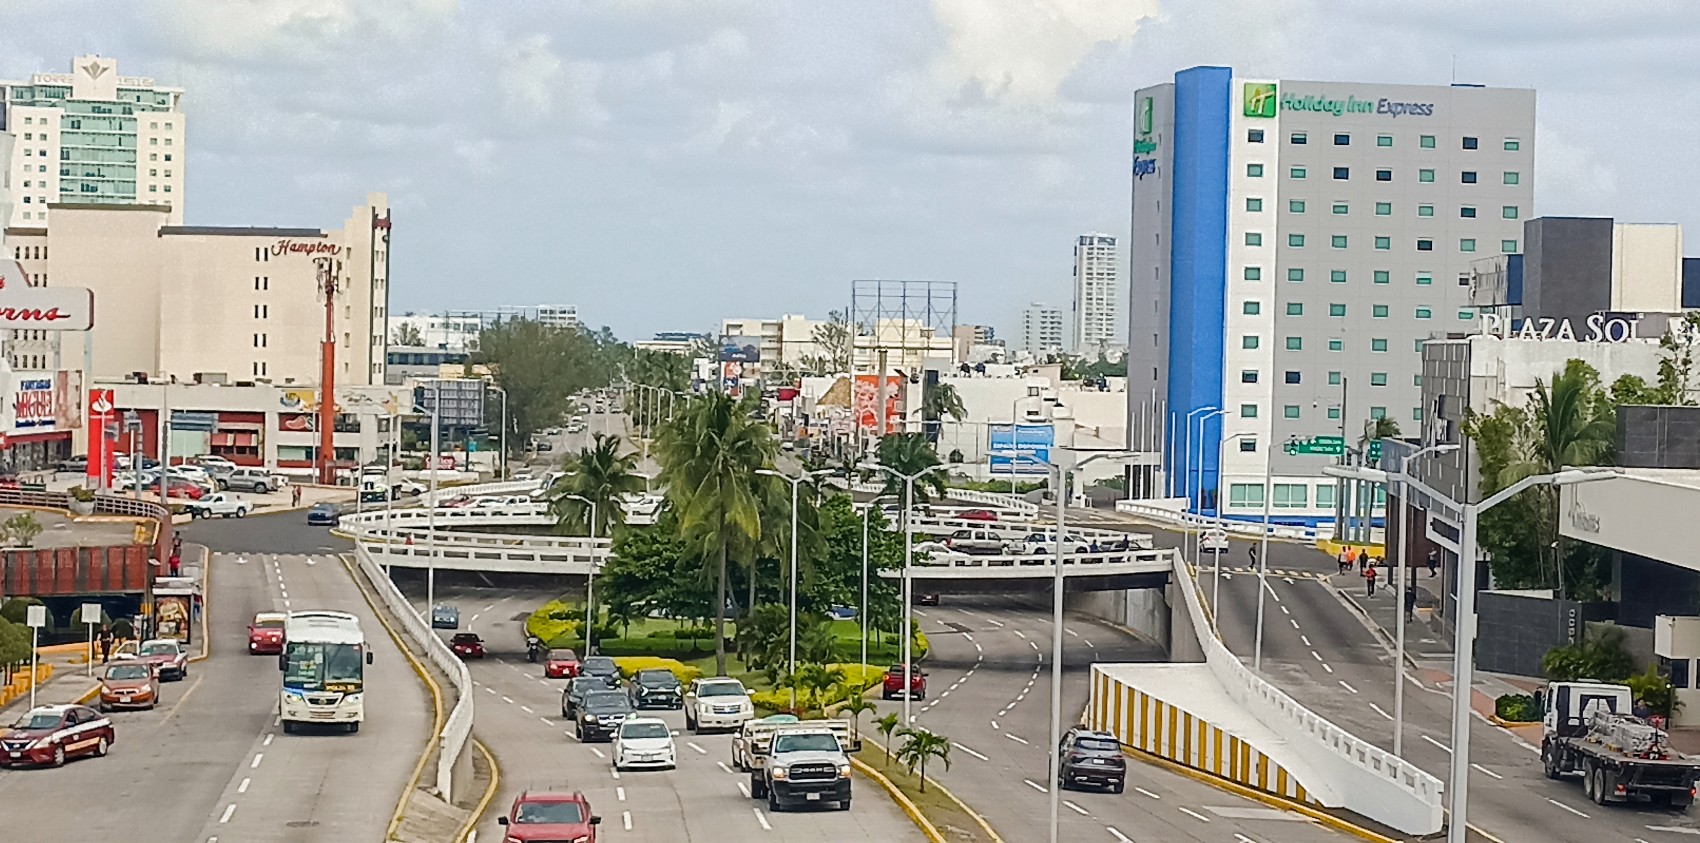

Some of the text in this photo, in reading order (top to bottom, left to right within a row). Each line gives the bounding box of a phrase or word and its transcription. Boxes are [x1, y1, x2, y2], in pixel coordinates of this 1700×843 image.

[1280, 92, 1434, 118] Holiday Inn Express
[271, 239, 342, 257] Hampton
[0, 307, 71, 321] rns
[1479, 313, 1578, 343] PLAZA
[1584, 314, 1641, 344] SOL
[12, 390, 52, 418] MIGUEL
